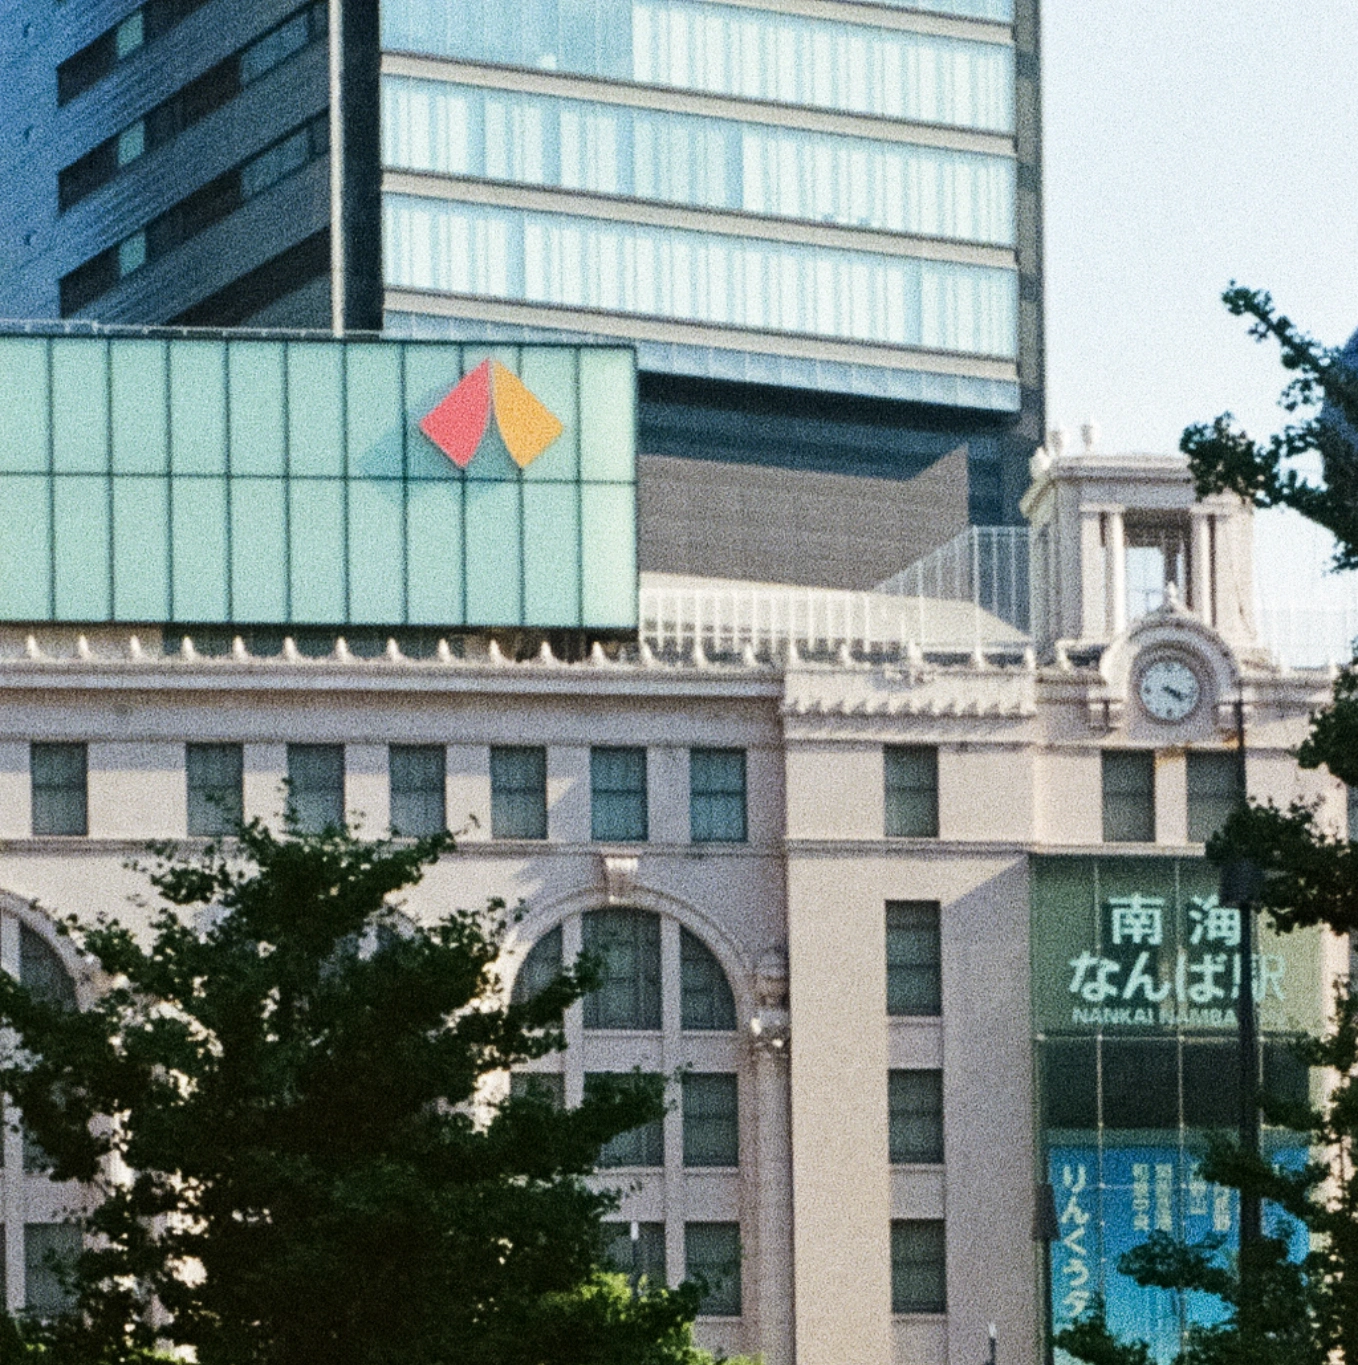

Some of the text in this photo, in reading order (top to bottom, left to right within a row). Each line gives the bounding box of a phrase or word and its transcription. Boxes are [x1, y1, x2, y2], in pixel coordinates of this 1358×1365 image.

[1107, 892, 1242, 946] 南海
[1068, 950, 1287, 1003] なんば駅
[1072, 1007, 1154, 1025] NANKAI
[1160, 1007, 1238, 1026] NAMBA
